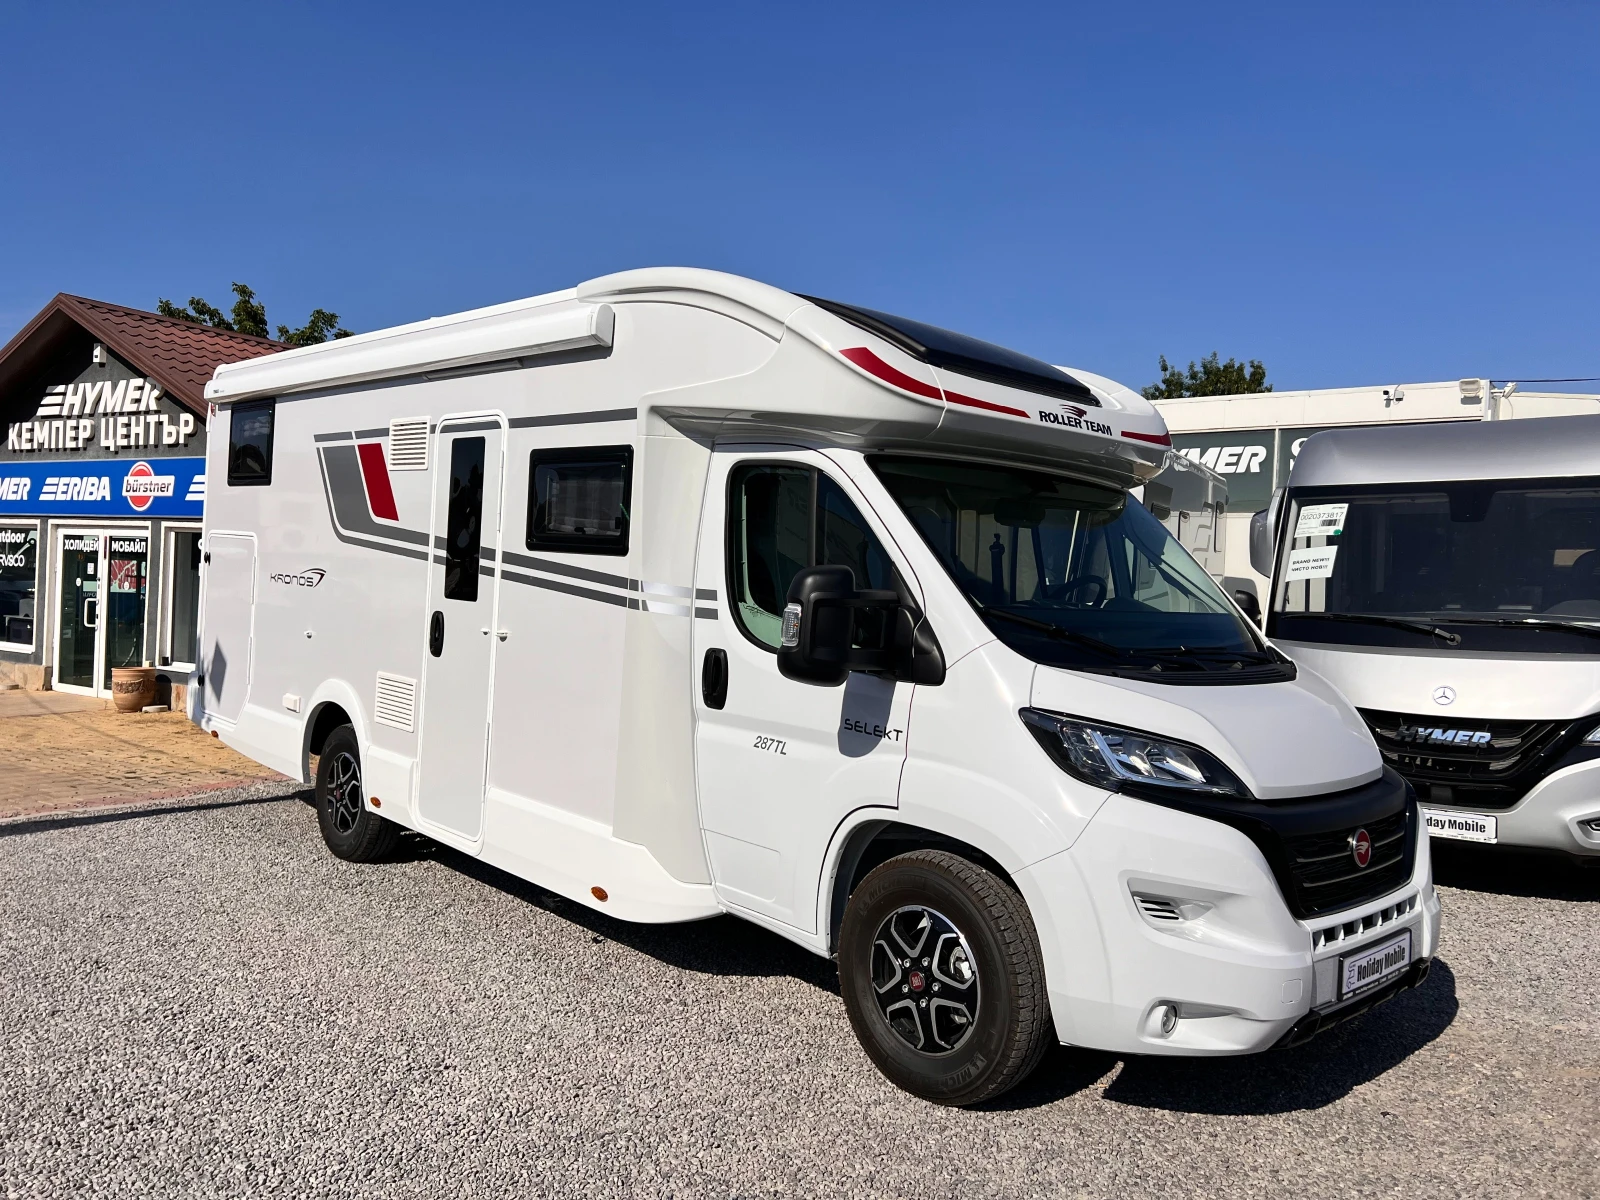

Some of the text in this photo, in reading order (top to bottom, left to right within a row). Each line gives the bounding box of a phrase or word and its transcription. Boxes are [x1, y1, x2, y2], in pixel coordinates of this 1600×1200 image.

[61, 378, 161, 416] HYMER
[8, 413, 196, 451] КЕМПЕР ЦЕНТЪР
[1039, 411, 1113, 436] ROLLER TEAM
[56, 477, 111, 500] ERIBA
[125, 479, 172, 494] bürstner
[1300, 511, 1344, 520] 0020373817
[64, 537, 99, 552] ХОЛИДЕЙ
[111, 538, 146, 552] МОБАЙЛ
[270, 573, 314, 588] KRONOS
[843, 718, 903, 742] SELEKT
[1398, 725, 1492, 748] HYMER
[753, 735, 787, 756] 287TL
[1448, 819, 1487, 833] Mobile
[1356, 944, 1406, 982] Holiday Mobile
